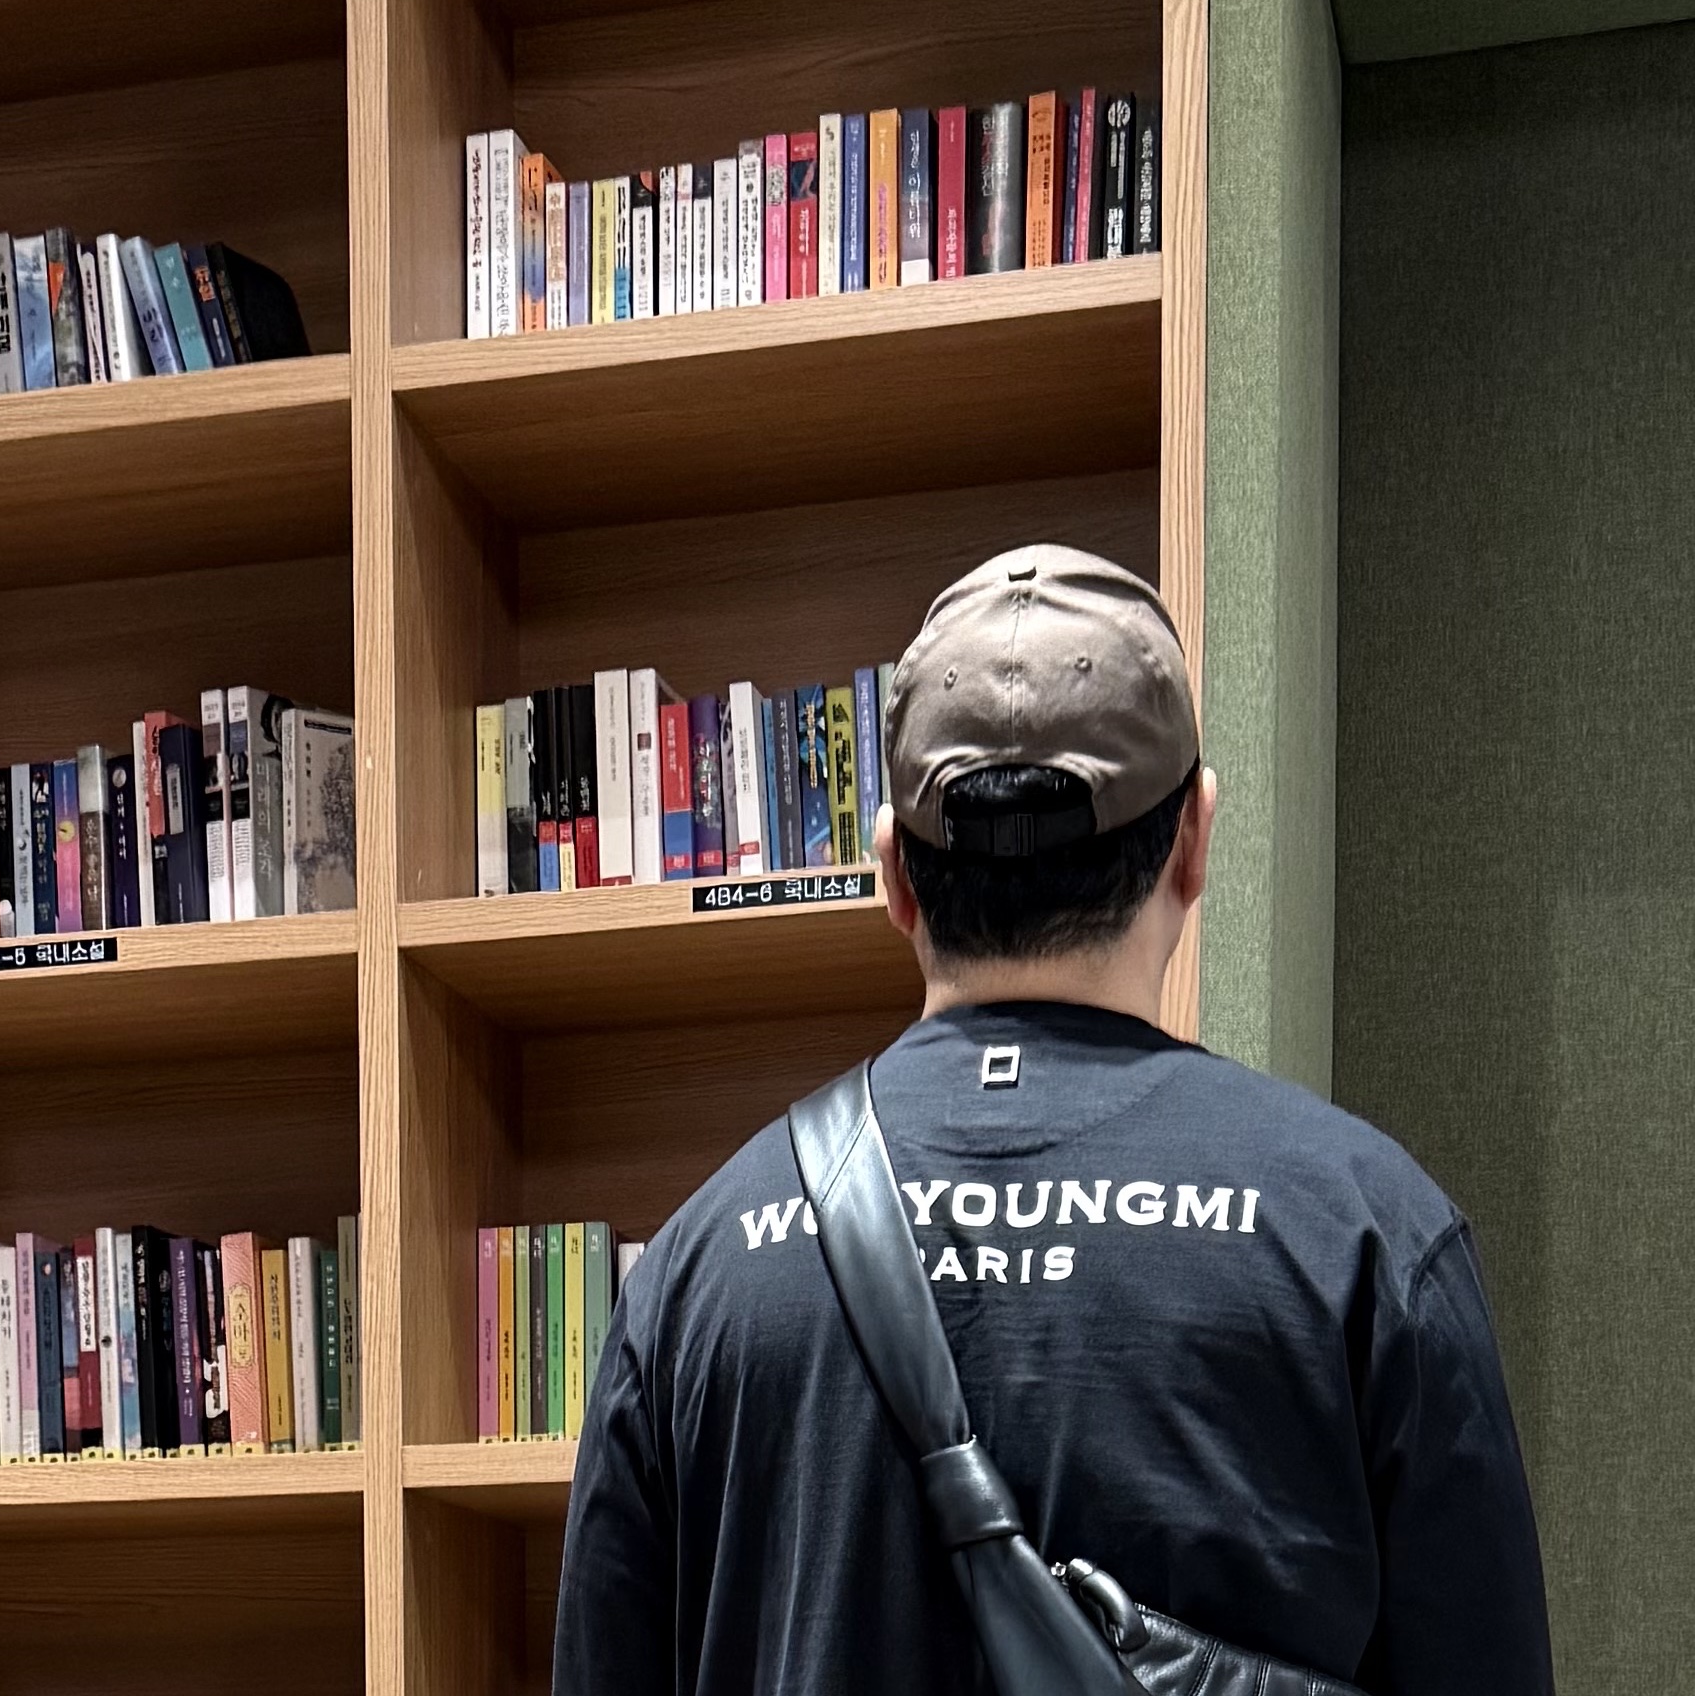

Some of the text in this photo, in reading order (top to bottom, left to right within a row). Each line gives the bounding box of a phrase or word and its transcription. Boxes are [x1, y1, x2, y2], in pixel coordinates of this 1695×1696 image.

[705, 873, 861, 906] 4B4-6 국내소설
[36, 940, 105, 964] 국내소설
[920, 1246, 1077, 1285] ARIS
